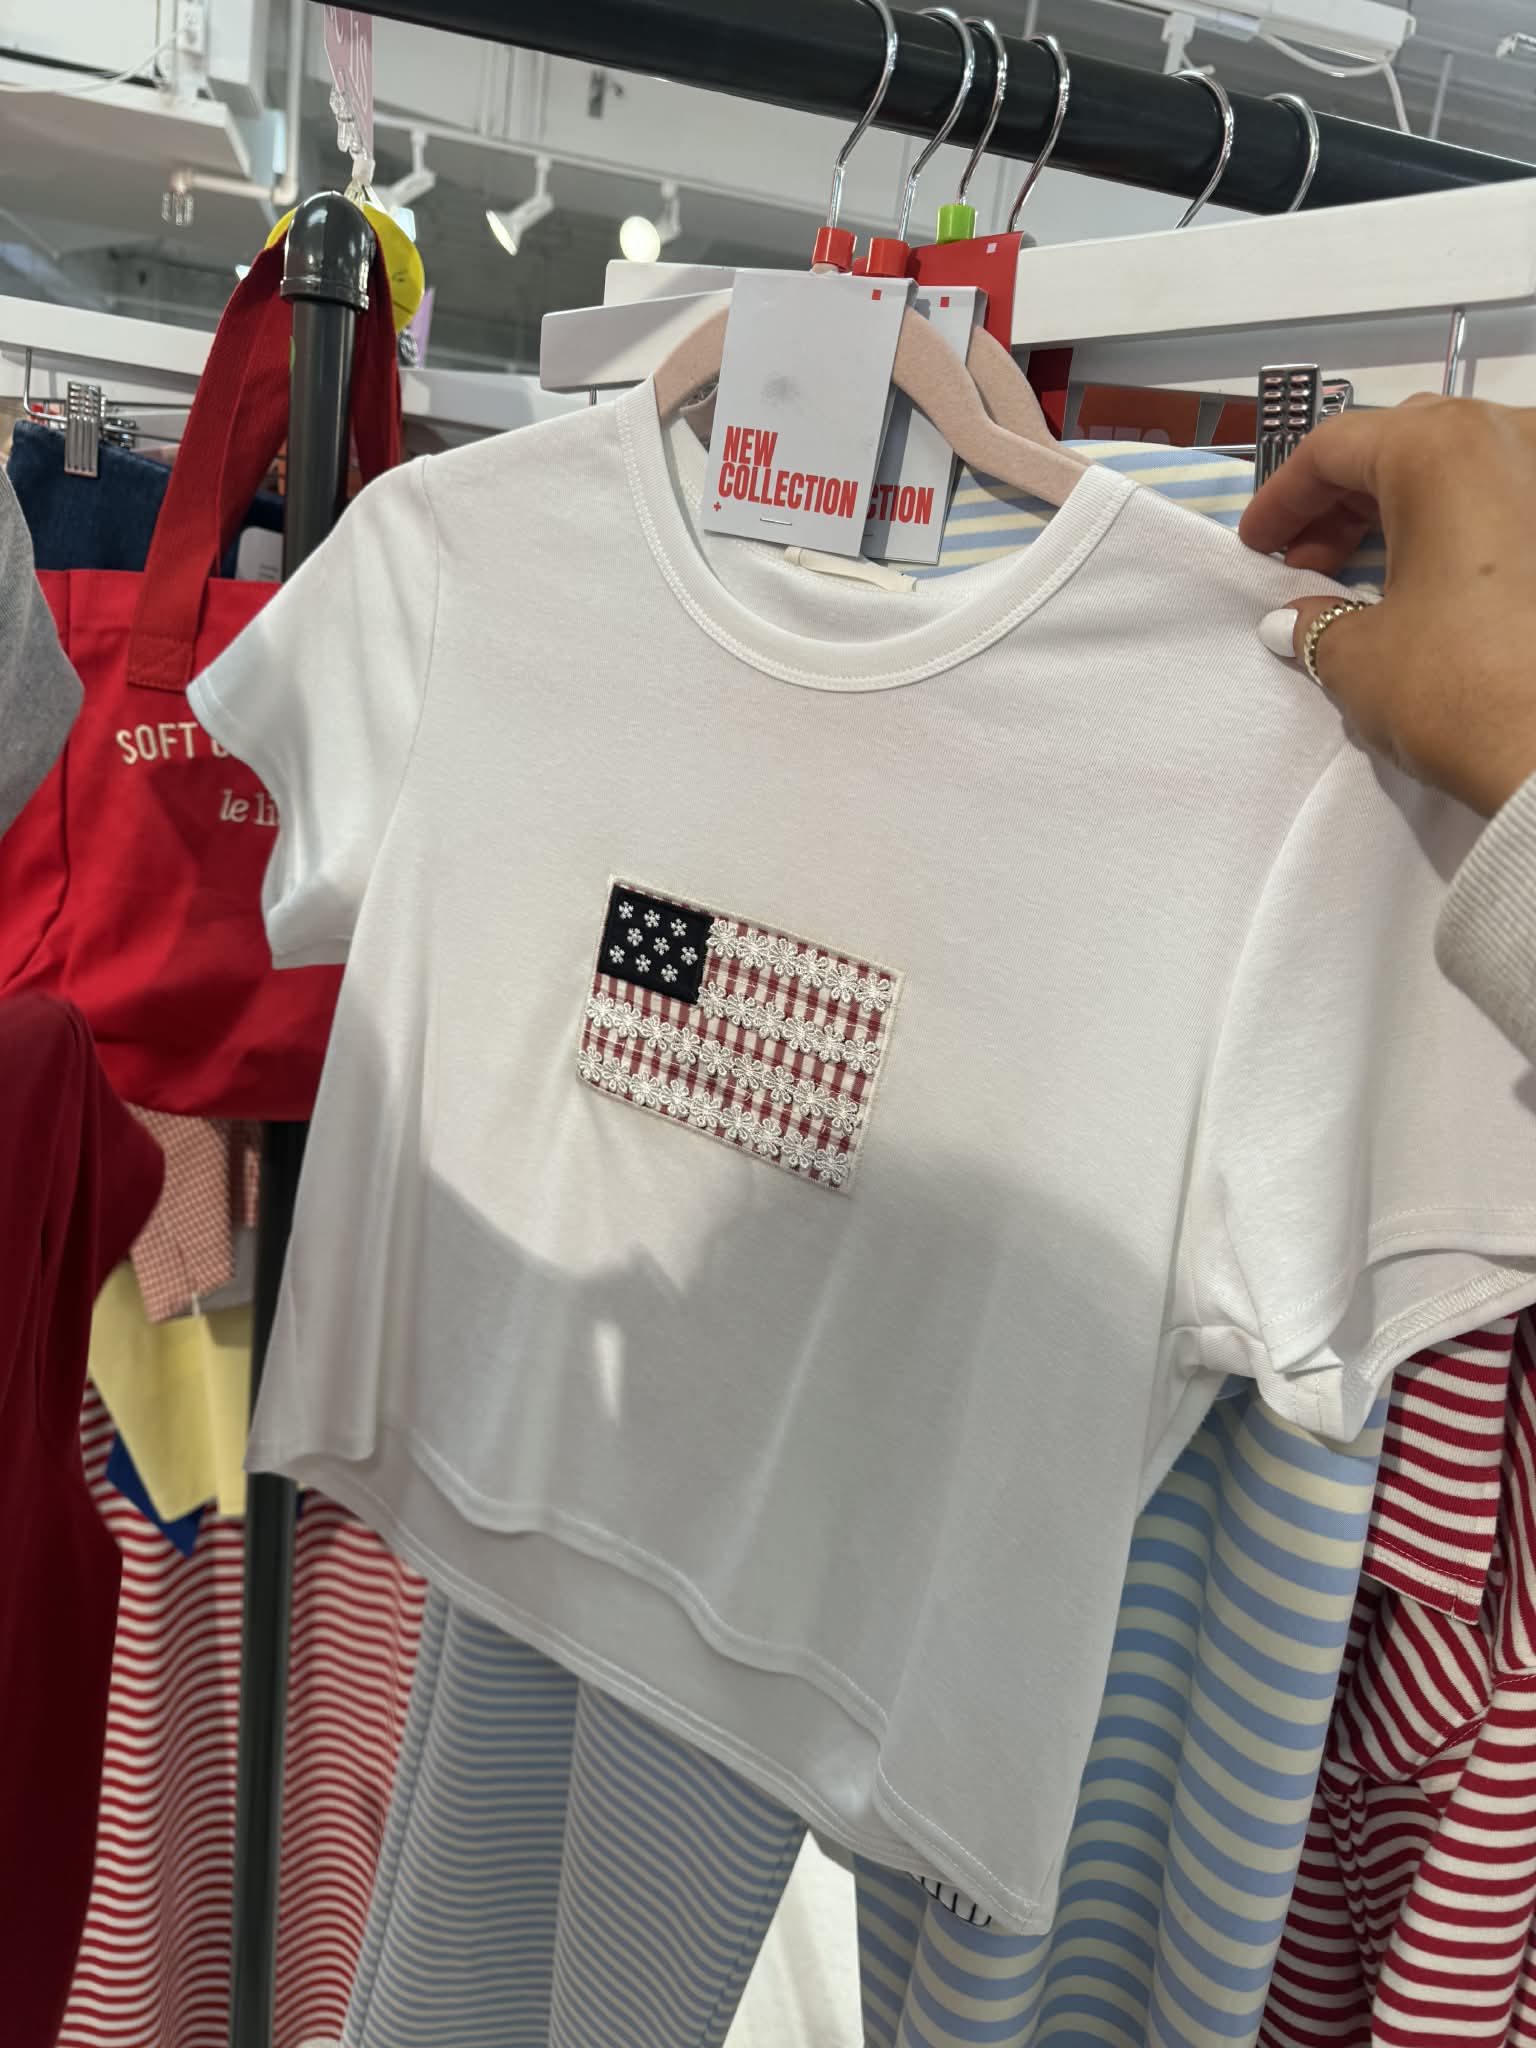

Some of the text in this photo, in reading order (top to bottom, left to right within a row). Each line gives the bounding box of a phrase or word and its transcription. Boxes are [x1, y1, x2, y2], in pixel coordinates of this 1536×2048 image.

[722, 425, 778, 468] NEW
[717, 462, 858, 519] COLLECTION
[116, 721, 198, 765] SOFT
[219, 789, 249, 823] le
